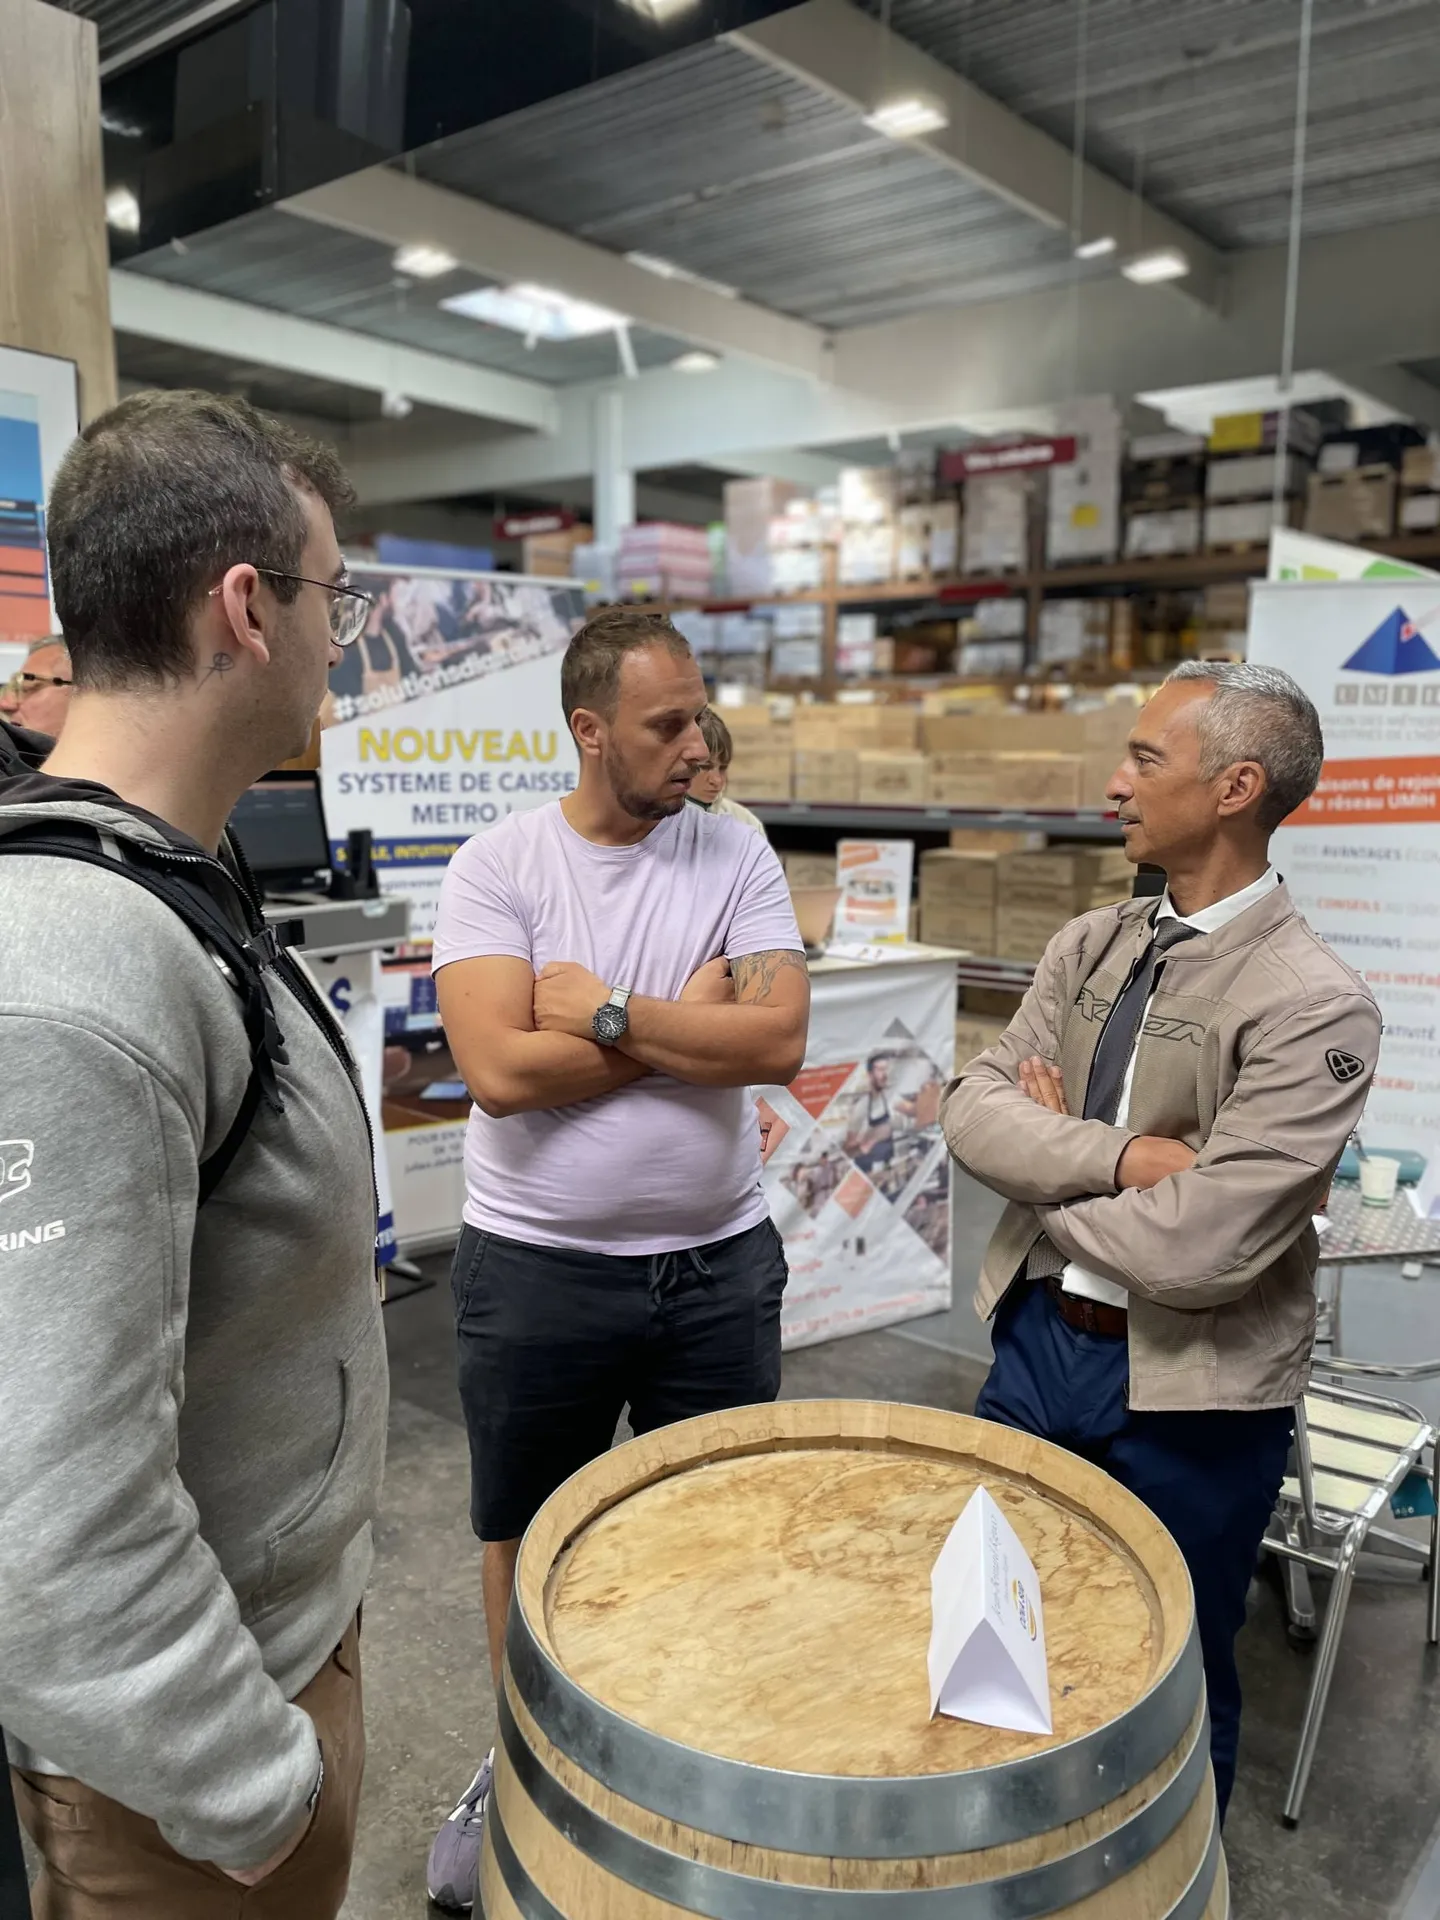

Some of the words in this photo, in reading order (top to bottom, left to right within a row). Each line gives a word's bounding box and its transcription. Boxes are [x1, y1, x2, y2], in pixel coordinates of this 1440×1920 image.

[358, 729, 558, 762] NOUVEAU
[338, 772, 452, 794] SYSTEME
[460, 772, 491, 792] DE
[498, 772, 576, 792] CAISSE
[1316, 778, 1370, 793] aisons
[1373, 774, 1395, 791] de
[1326, 794, 1385, 811] réseau
[411, 803, 498, 824] METRO
[1321, 845, 1402, 861] AVANTAGES
